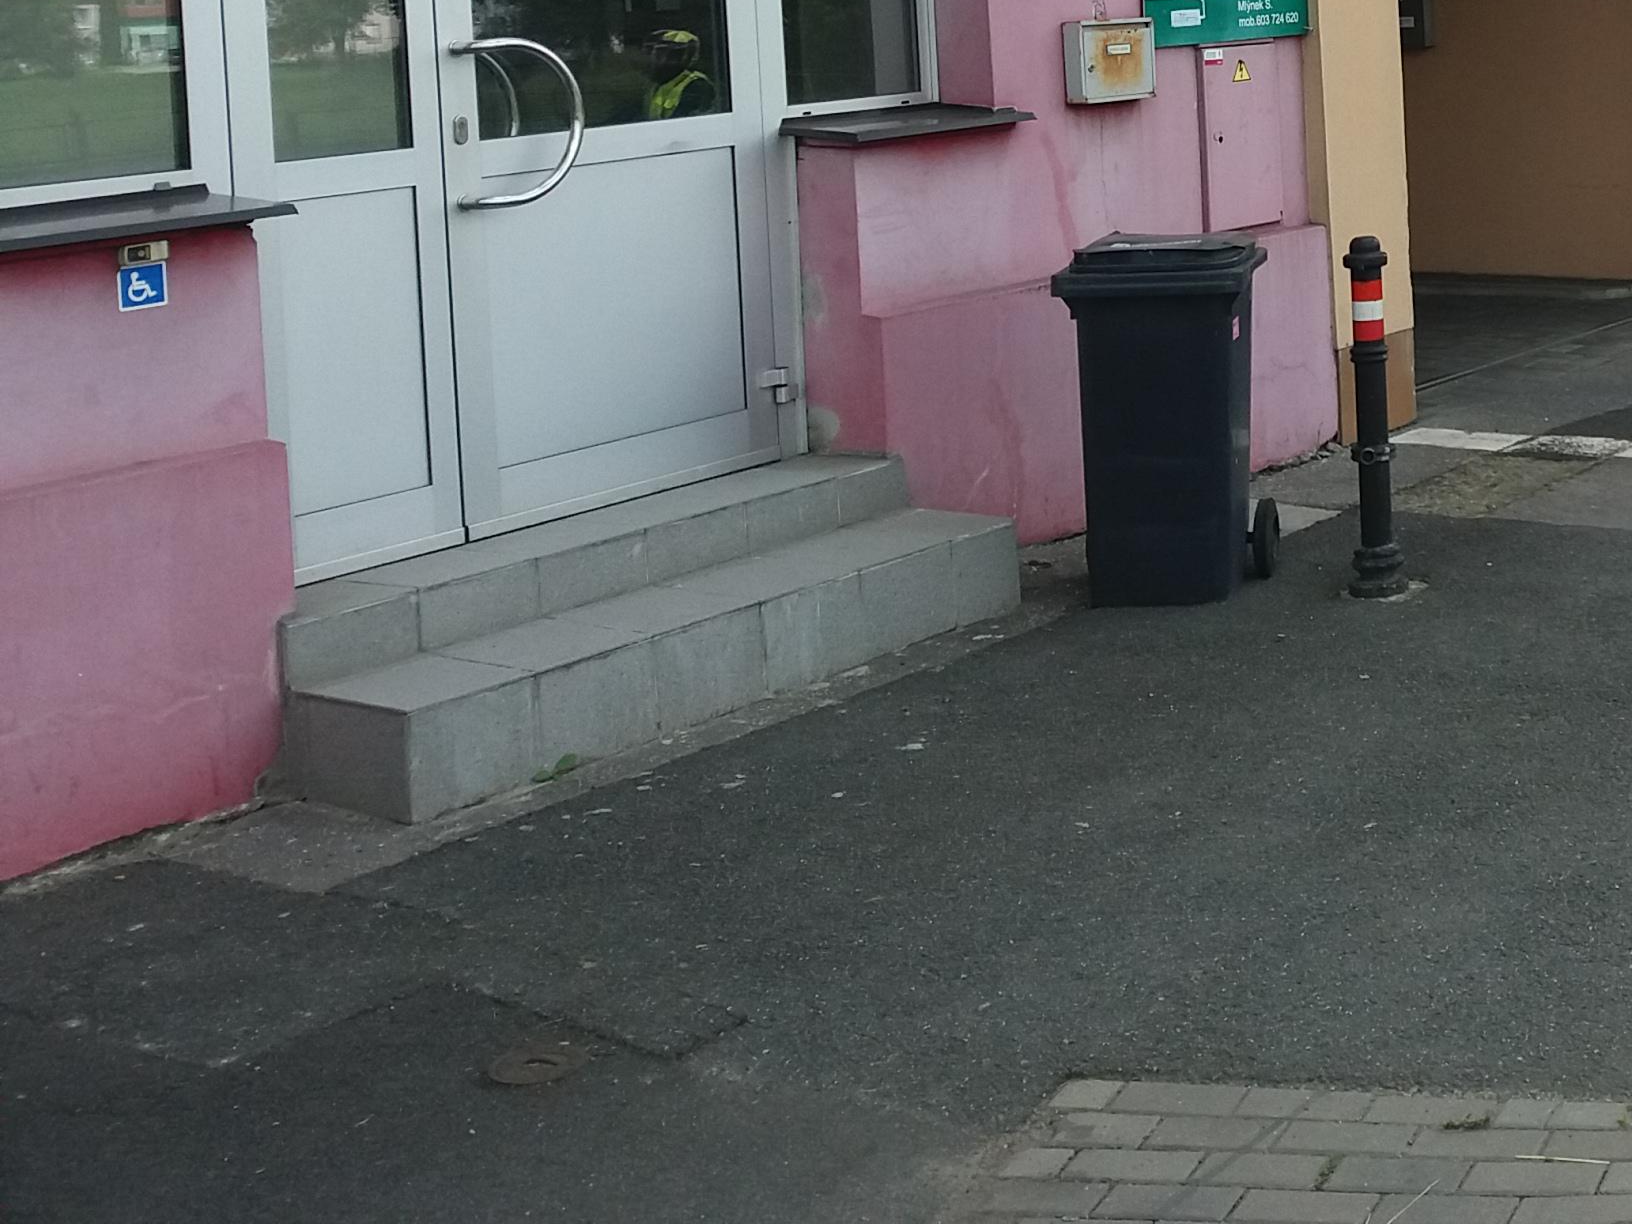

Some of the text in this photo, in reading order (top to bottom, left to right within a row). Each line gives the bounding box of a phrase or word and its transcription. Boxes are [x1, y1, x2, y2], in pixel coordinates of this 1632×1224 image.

[1238, 0, 1273, 14] Mlýnek S.
[1271, 14, 1285, 25] 724
[1286, 12, 1299, 24] 620
